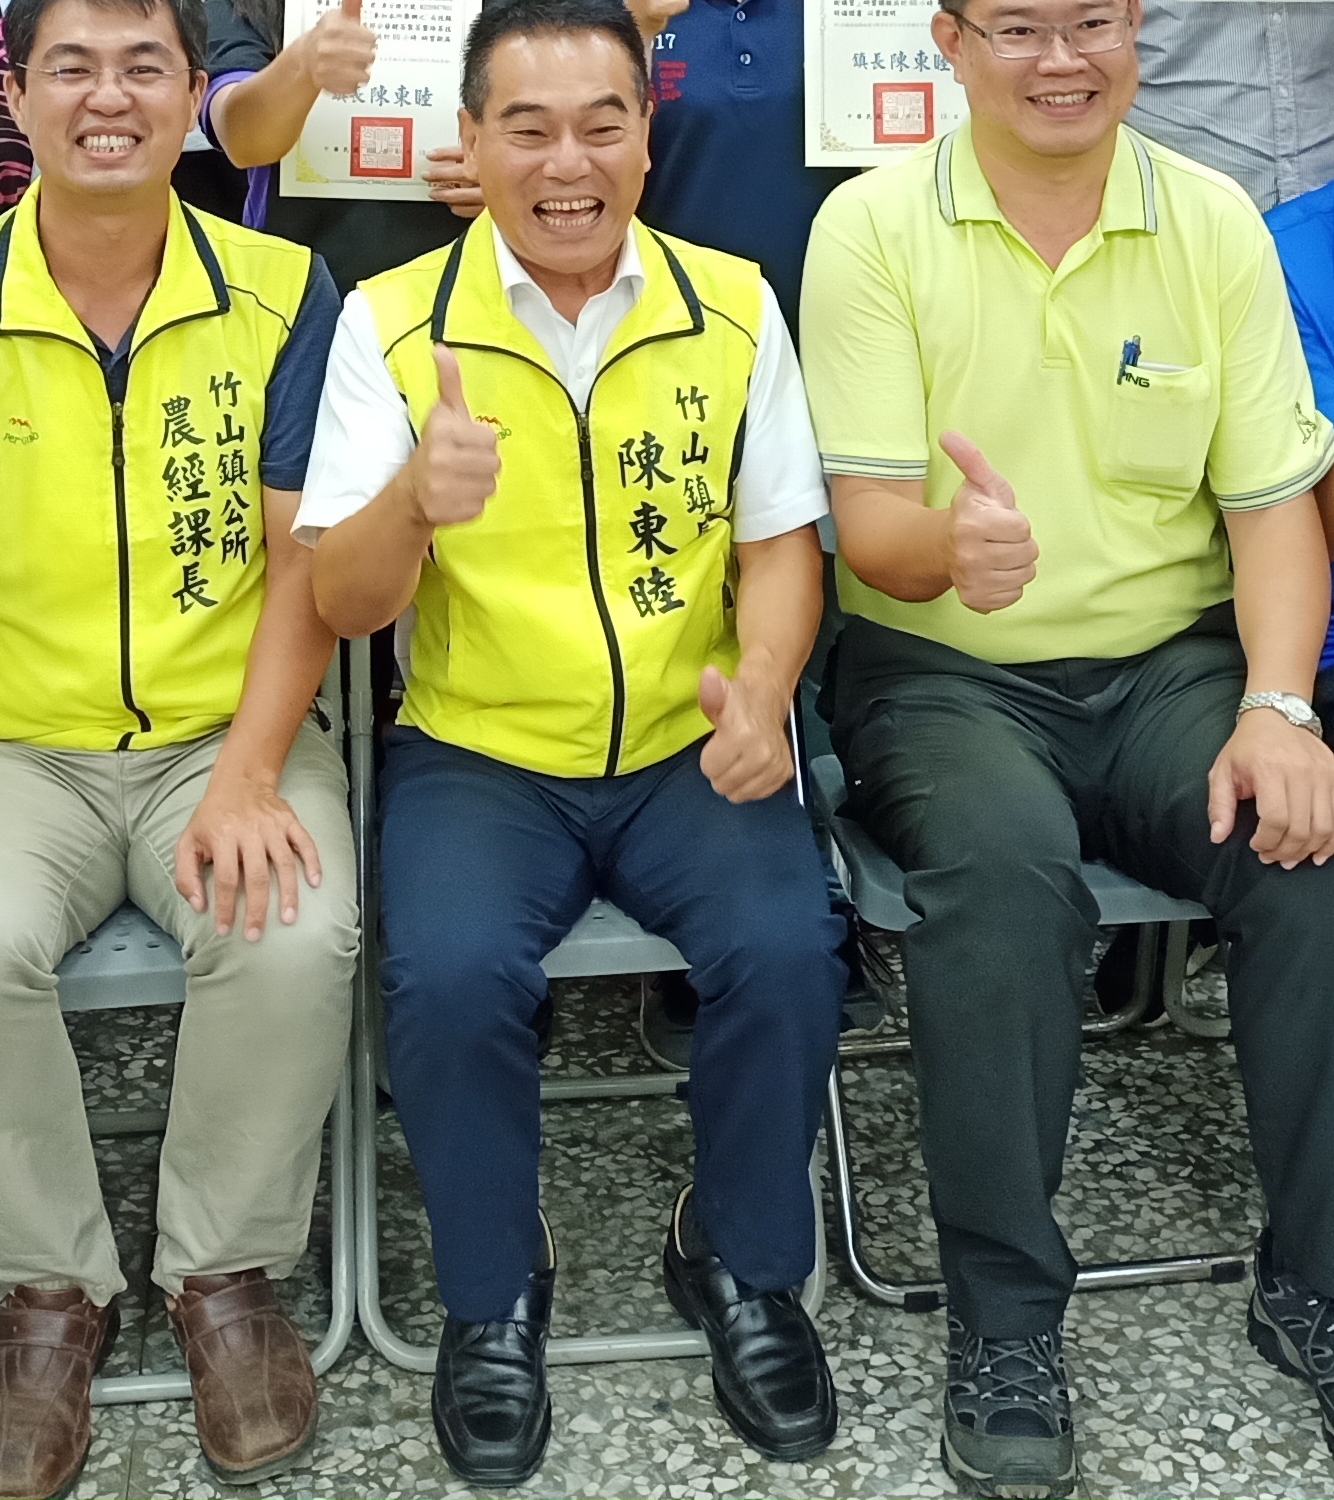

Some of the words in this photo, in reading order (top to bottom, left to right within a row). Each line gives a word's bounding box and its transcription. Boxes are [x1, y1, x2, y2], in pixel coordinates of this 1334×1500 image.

[160, 395, 219, 615] 農經課長
[208, 370, 250, 566] 竹山鎮公所
[617, 430, 685, 619] 陳東睦
